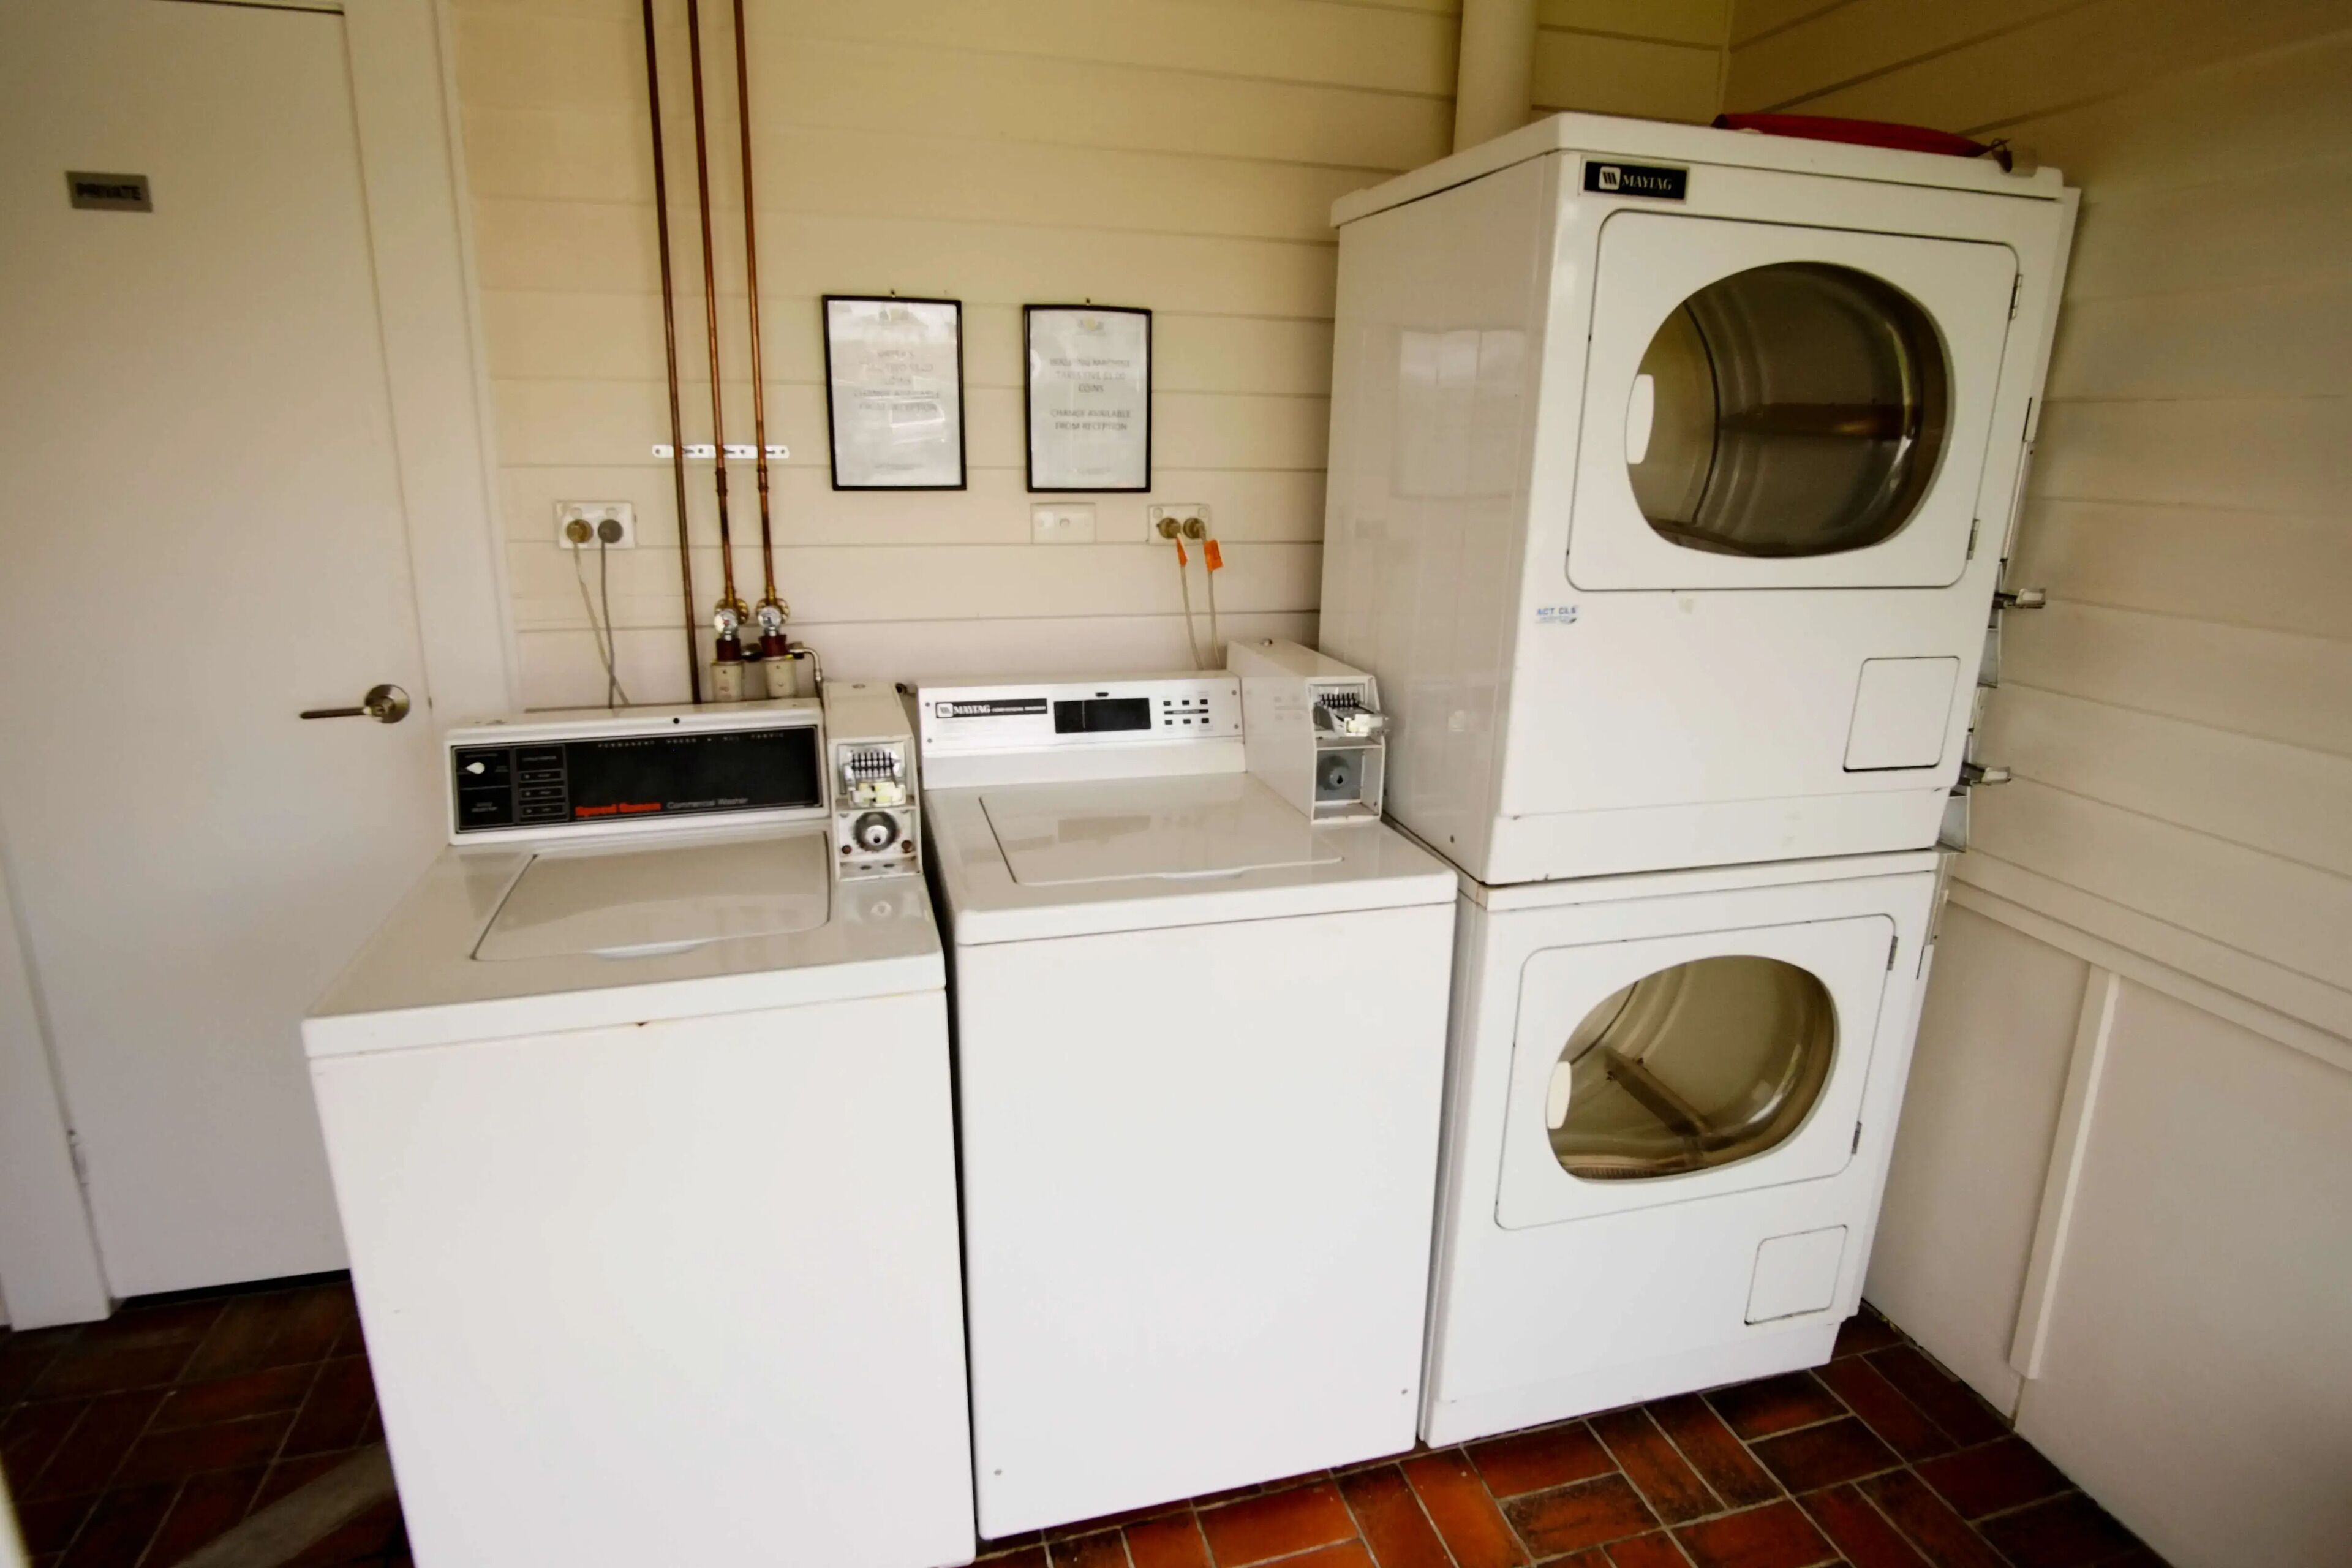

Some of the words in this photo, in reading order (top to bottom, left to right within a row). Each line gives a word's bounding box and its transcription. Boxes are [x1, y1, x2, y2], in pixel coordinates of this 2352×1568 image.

[1622, 174, 1673, 191] MAYTAG
[1087, 409, 1131, 418] AVAILABLE
[1055, 422, 1080, 431] FROM
[953, 704, 991, 715] MAYTAG
